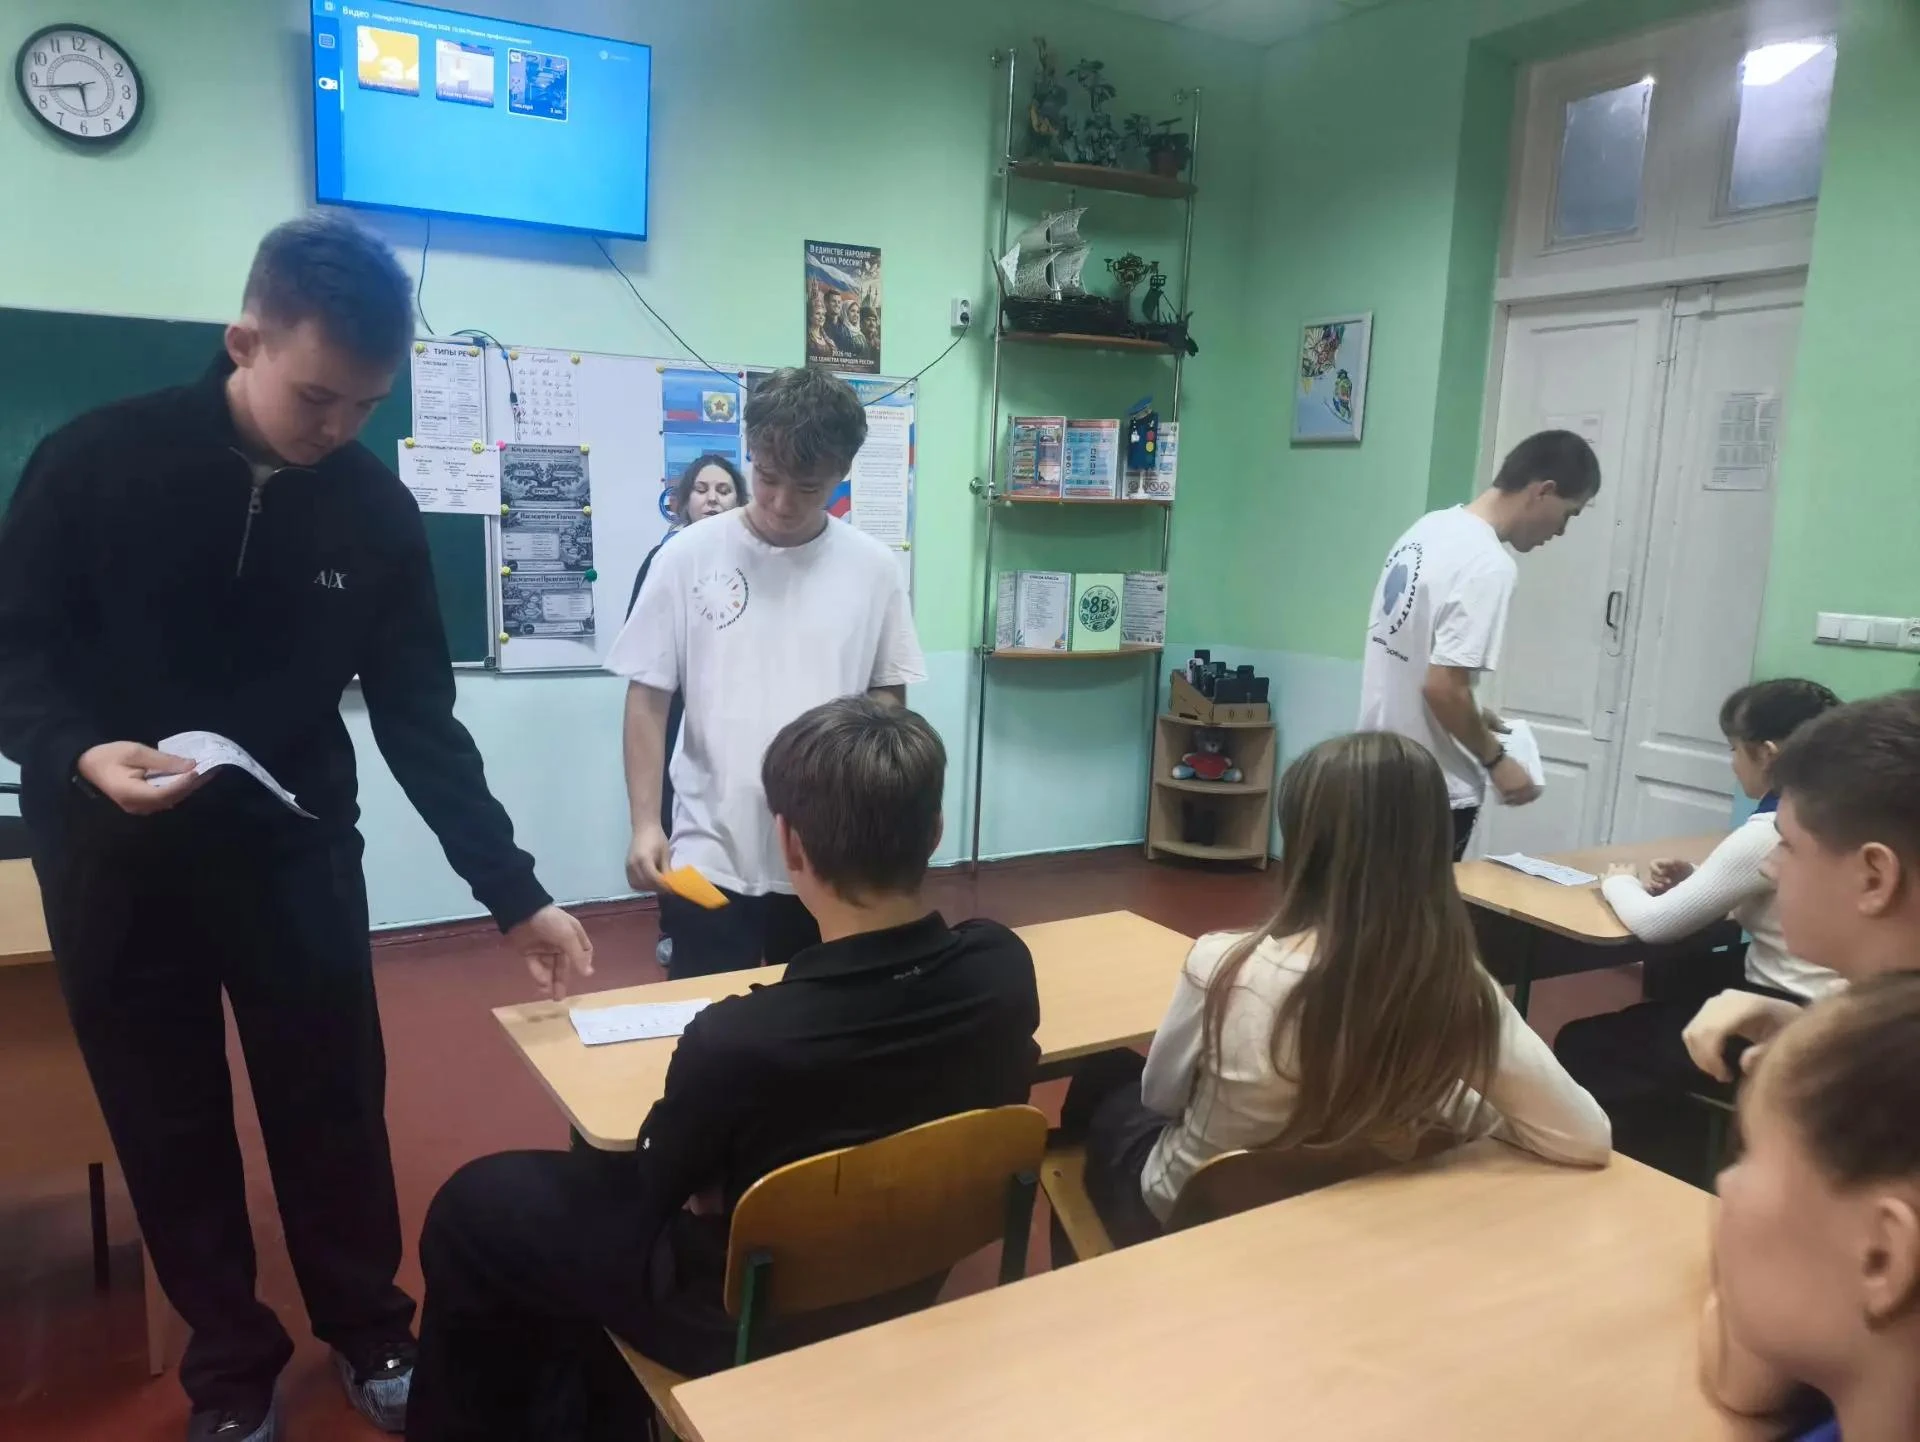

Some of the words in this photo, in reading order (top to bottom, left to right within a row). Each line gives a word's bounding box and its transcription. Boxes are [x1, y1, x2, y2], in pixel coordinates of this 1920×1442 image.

[342, 6, 370, 19] Видео
[50, 39, 60, 53] 11
[72, 35, 86, 52] 12
[34, 52, 47, 66] 10
[97, 45, 103, 60] 1
[114, 63, 123, 77] 2
[31, 72, 38, 87] 9
[122, 85, 131, 100] 3
[39, 95, 48, 109] 8
[57, 112, 64, 125] 7
[117, 106, 125, 120] 4
[80, 121, 88, 134] 6
[104, 119, 111, 132] 5
[815, 246, 844, 256] ЕДИНСТВЕ
[844, 249, 871, 259] НАРОДОВ
[434, 348, 457, 356] ТИПЫ
